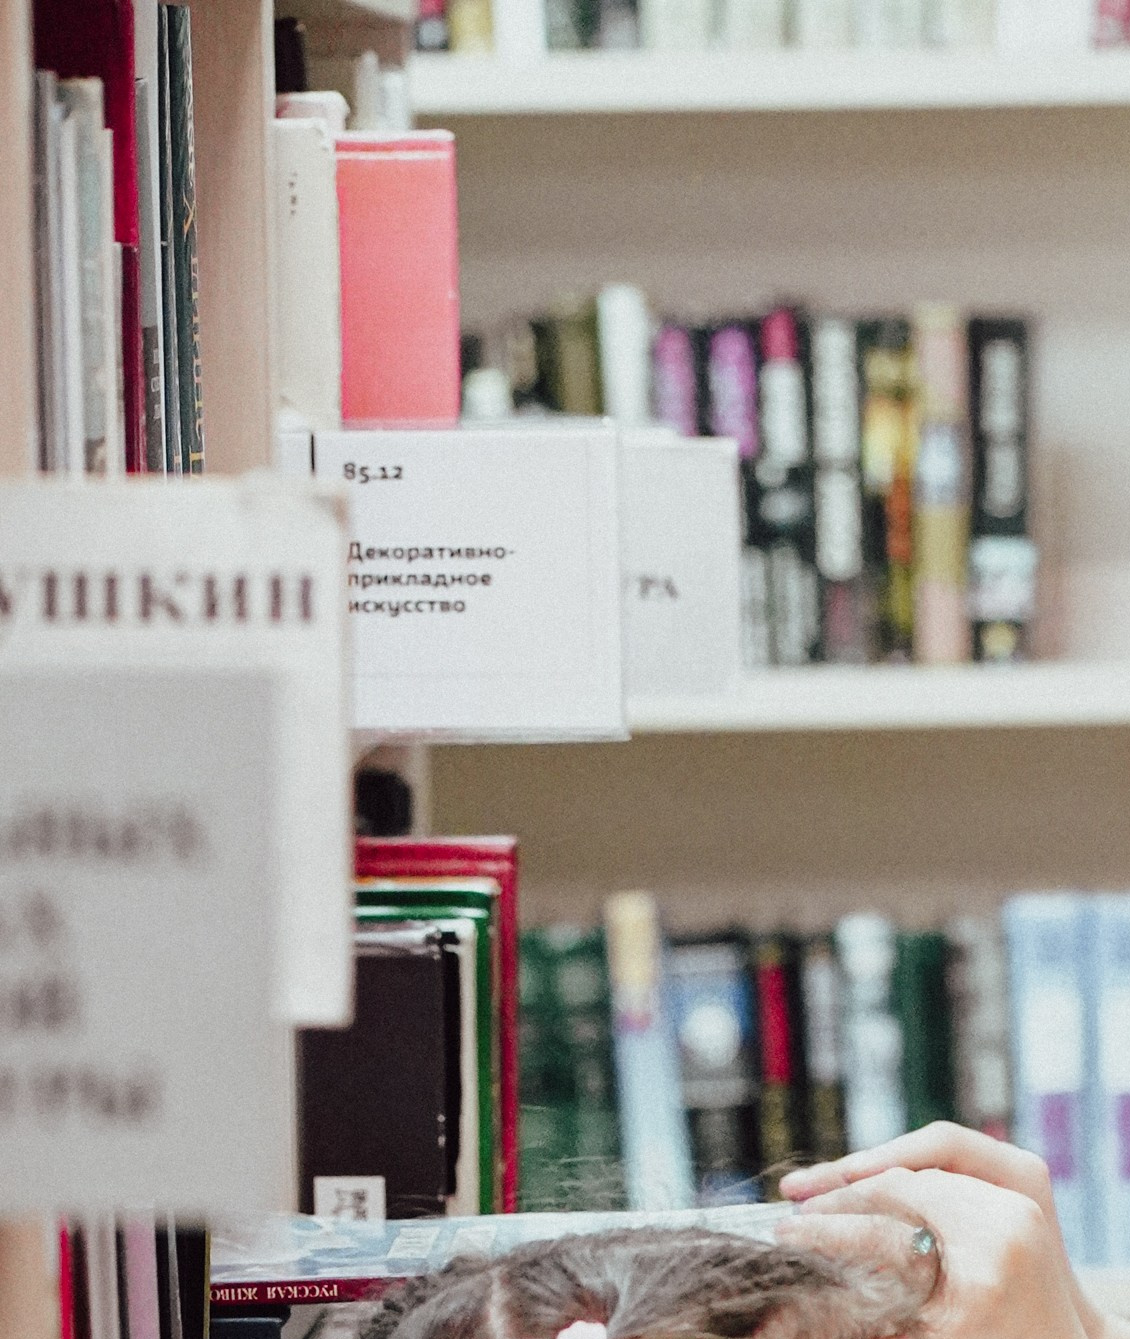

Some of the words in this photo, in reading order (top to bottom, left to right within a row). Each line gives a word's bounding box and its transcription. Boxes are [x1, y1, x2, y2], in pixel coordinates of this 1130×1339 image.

[343, 463, 403, 484] 85.12
[347, 542, 515, 562] Декоративно-
[347, 573, 492, 589] прикладное
[347, 598, 466, 617] искусство
[267, 1284, 339, 1300] РУССКАЯ
